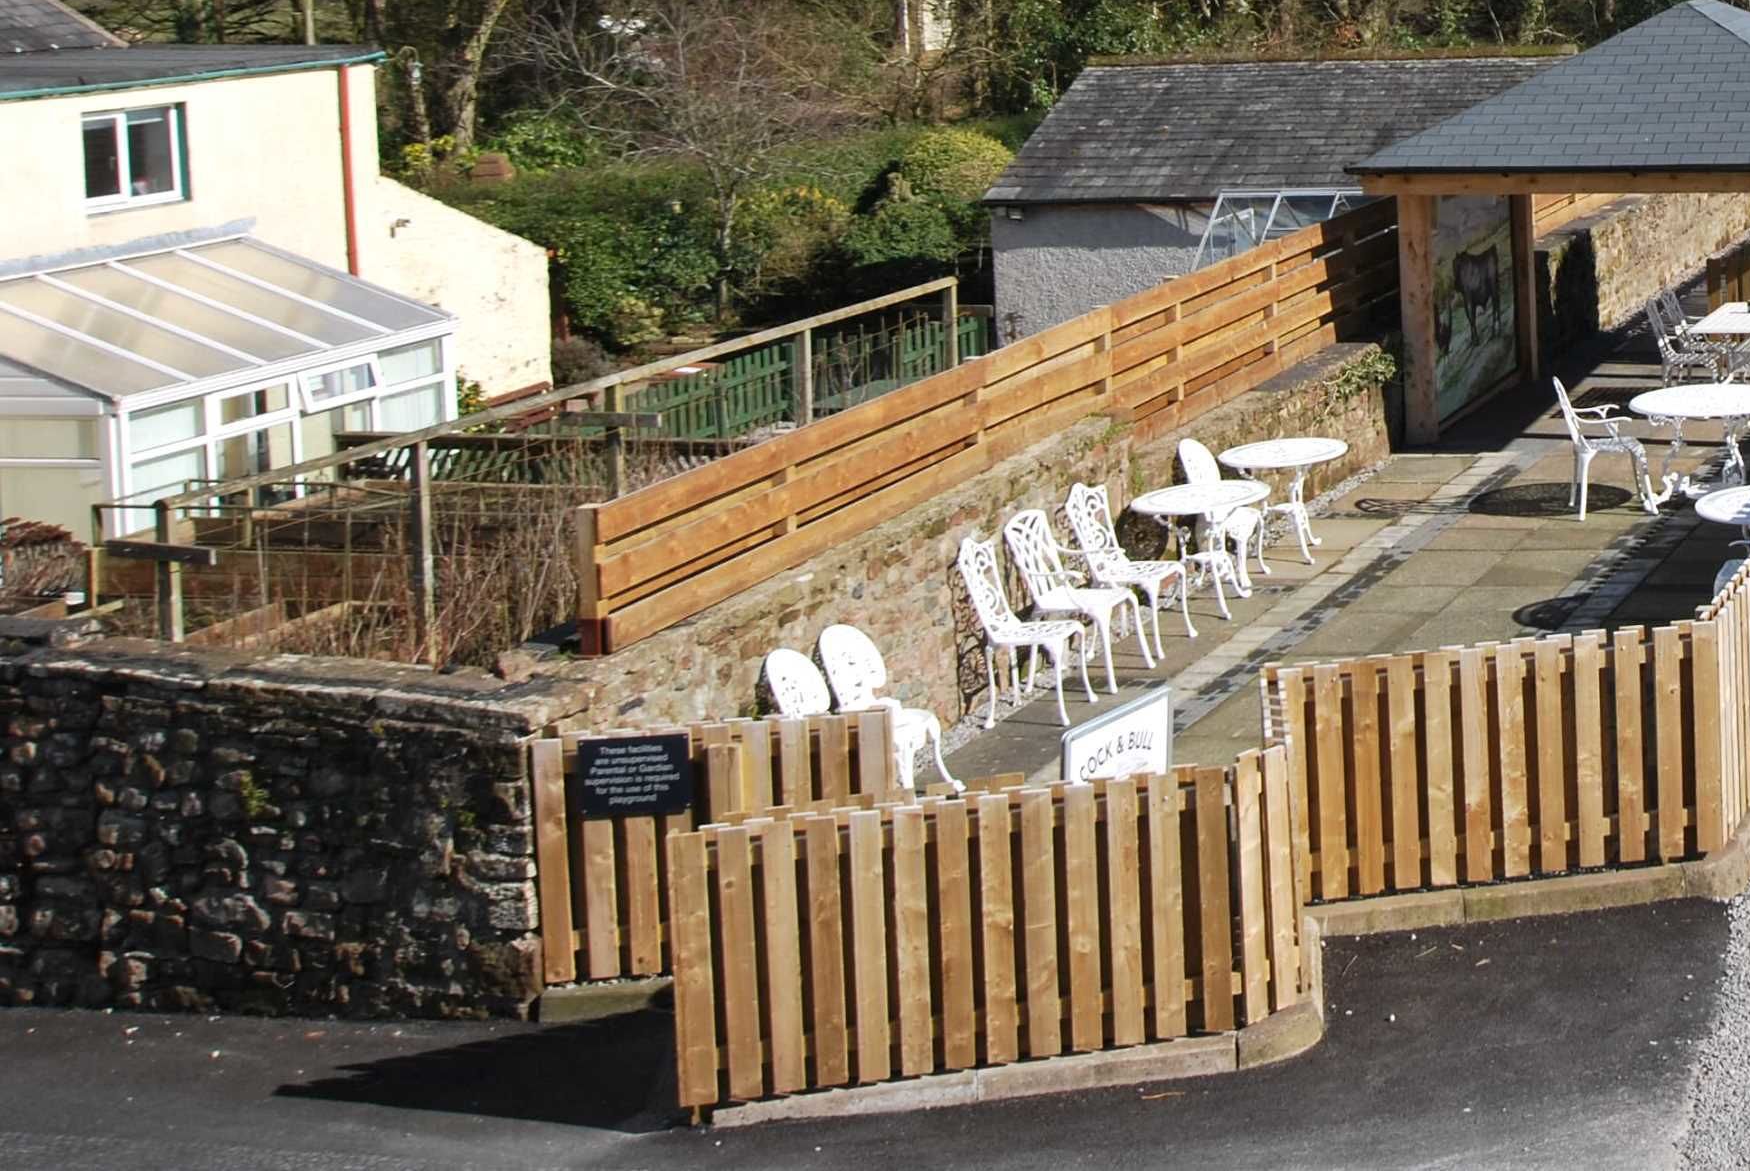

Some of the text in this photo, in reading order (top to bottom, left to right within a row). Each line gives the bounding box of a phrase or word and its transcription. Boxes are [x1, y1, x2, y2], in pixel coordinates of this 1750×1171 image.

[600, 745, 663, 754] These facilities
[612, 754, 668, 764] unsupervised
[1080, 741, 1112, 782] COCK
[1116, 735, 1125, 754] &
[1128, 730, 1154, 750] BULL
[590, 766, 626, 775] Parental
[584, 776, 633, 786] supervision
[644, 773, 680, 782] required
[643, 784, 652, 792] of
[608, 794, 657, 805] playground
